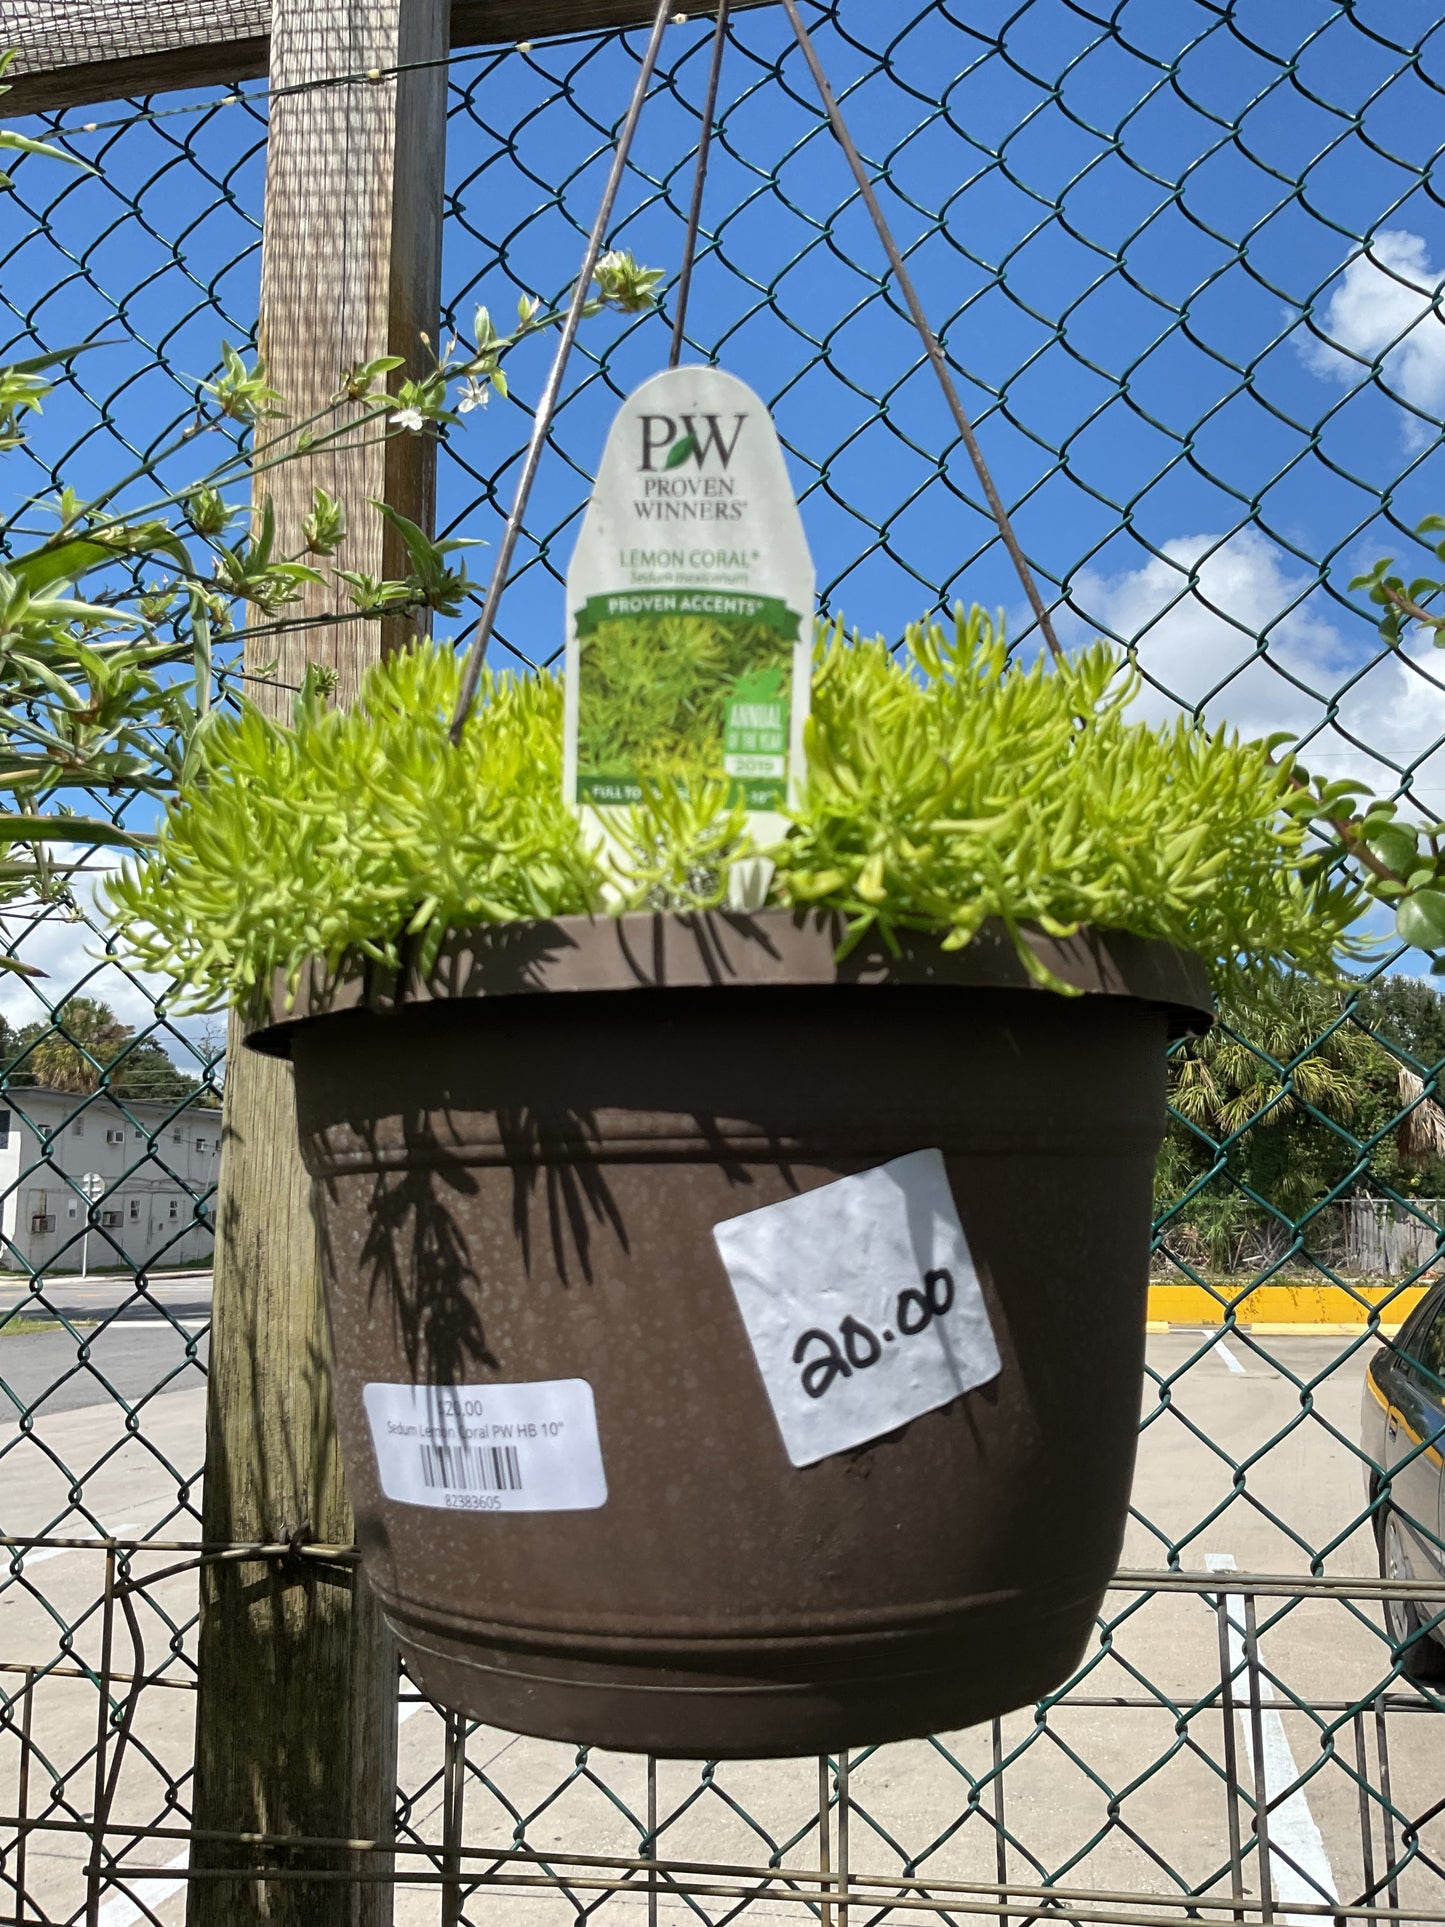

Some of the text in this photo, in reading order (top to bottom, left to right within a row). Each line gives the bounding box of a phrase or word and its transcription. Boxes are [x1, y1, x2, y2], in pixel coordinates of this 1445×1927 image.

[636, 413, 750, 473] PW
[644, 478, 735, 498] PROVEN
[633, 501, 743, 521] WINNERS
[620, 549, 750, 569] LEMON CORAL
[608, 594, 757, 617] PROVEN ACCENTS
[592, 784, 621, 800] FULL
[623, 785, 642, 800] TO
[793, 1267, 955, 1399] 20.00
[419, 1424, 456, 1438] Lemon
[458, 1422, 490, 1440] Coral
[492, 1425, 514, 1439] PW
[517, 1425, 537, 1439] HB
[445, 1493, 502, 1510] 82383605
